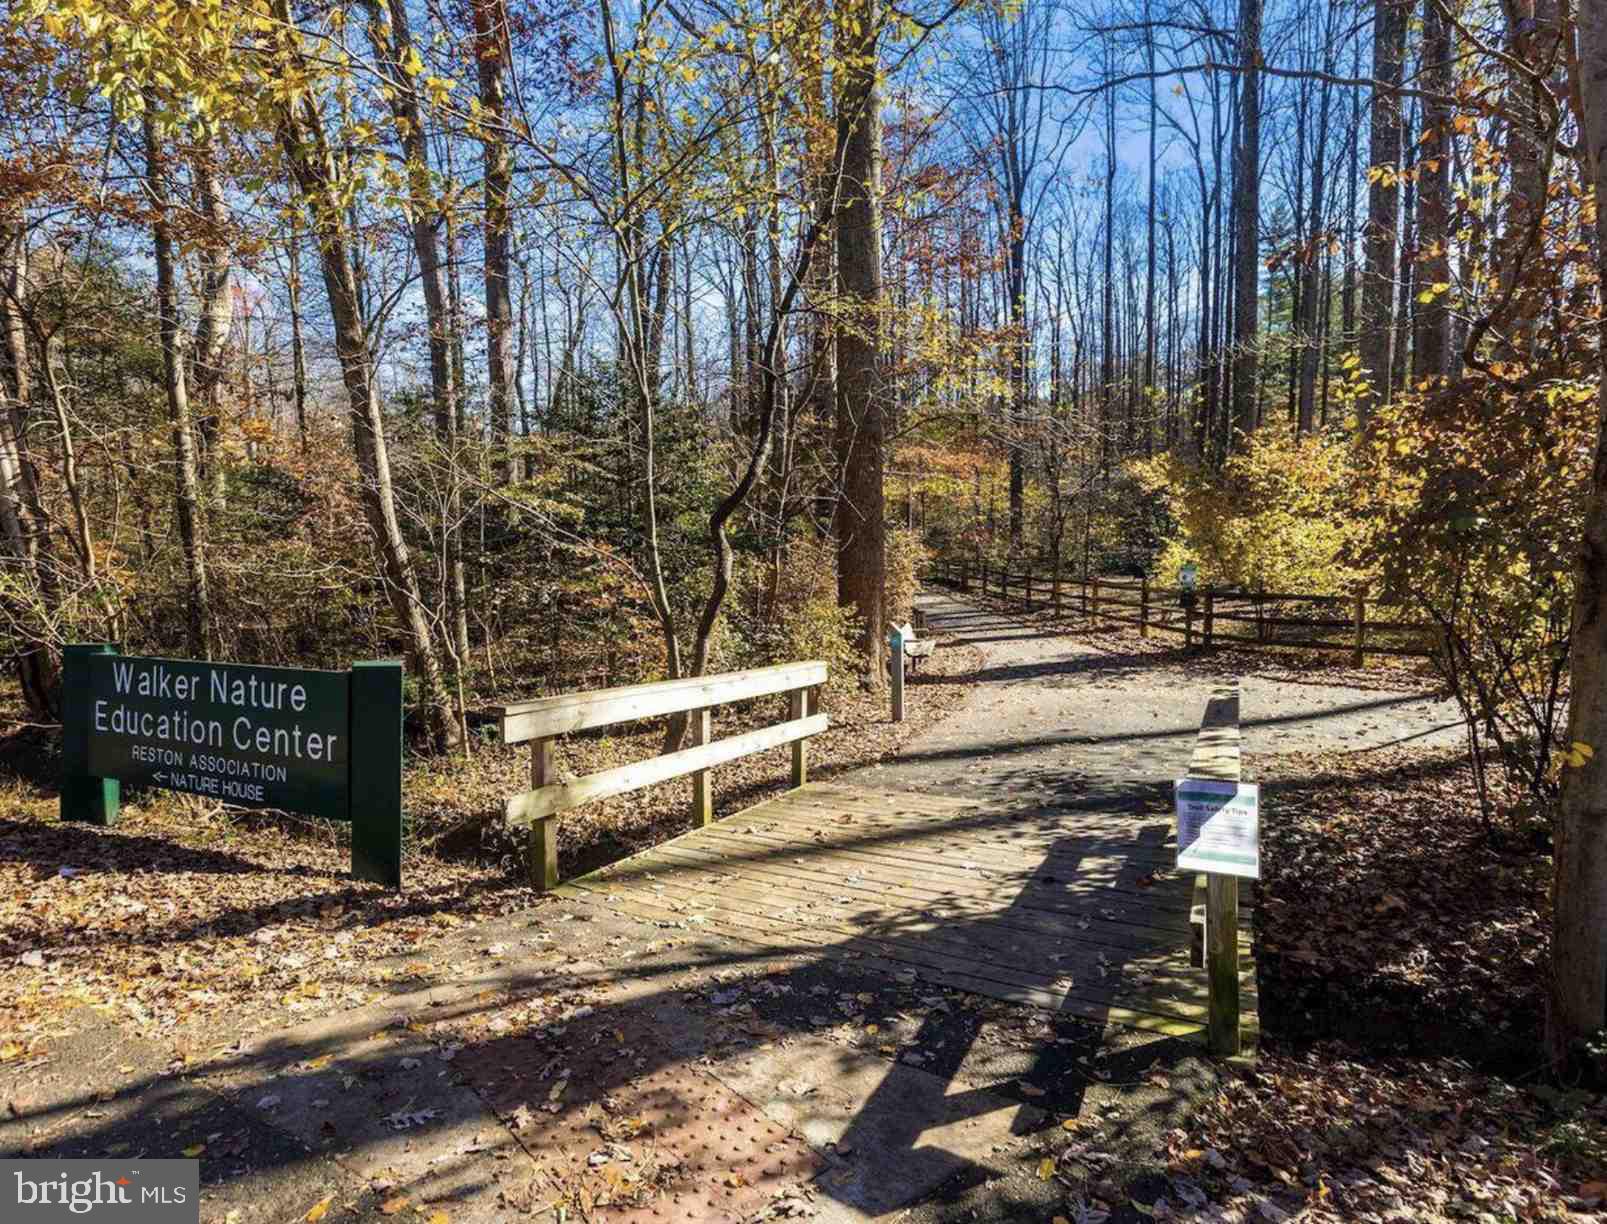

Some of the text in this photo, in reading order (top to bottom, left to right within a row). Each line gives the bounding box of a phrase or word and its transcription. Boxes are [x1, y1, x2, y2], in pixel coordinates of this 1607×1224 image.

[112, 661, 306, 711] Walker Nature
[95, 699, 337, 761] Education Center
[131, 745, 287, 782] RESTON ASSOCIATION
[170, 772, 265, 801] NATURE HOUSE
